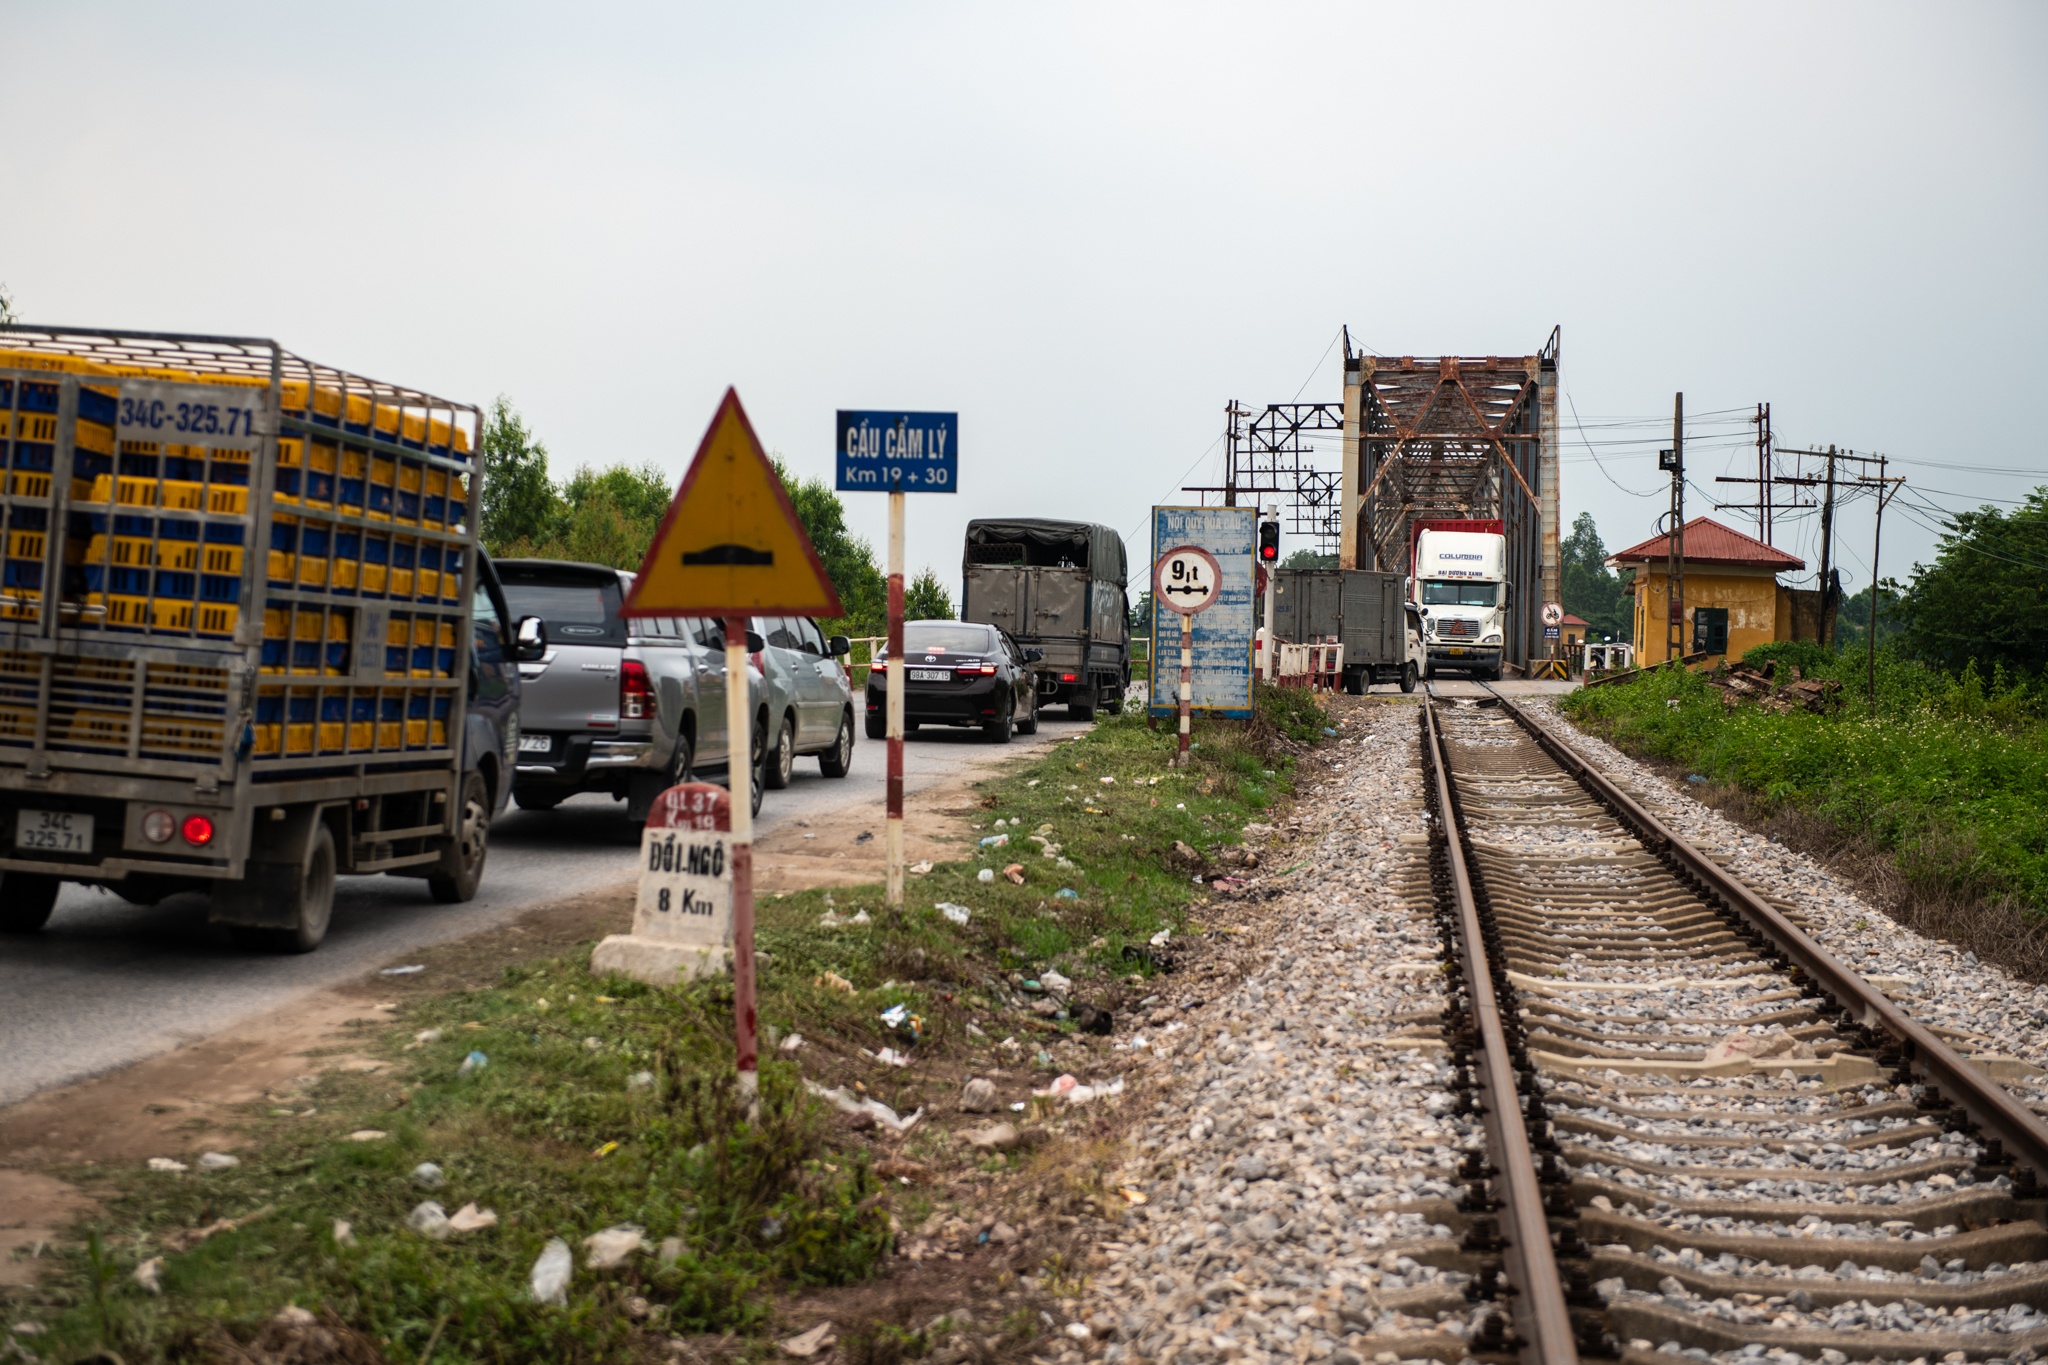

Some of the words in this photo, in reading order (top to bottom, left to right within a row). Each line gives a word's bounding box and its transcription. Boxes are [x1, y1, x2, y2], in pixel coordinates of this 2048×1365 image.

[120, 397, 253, 436] 34C-325.71
[846, 417, 880, 459] CẦU
[928, 422, 947, 459] LÝ
[846, 466, 877, 482] Km
[882, 467, 902, 483] 19
[907, 471, 919, 483] +
[925, 467, 948, 484] 30
[1439, 553, 1483, 561] COLUMBIA
[911, 670, 949, 680] 98A-307.15
[665, 790, 688, 811] QL
[692, 792, 719, 814] 37
[39, 812, 73, 831] 34C
[24, 829, 83, 850] 325.71
[658, 887, 671, 912] 8
[682, 888, 713, 916] Km
